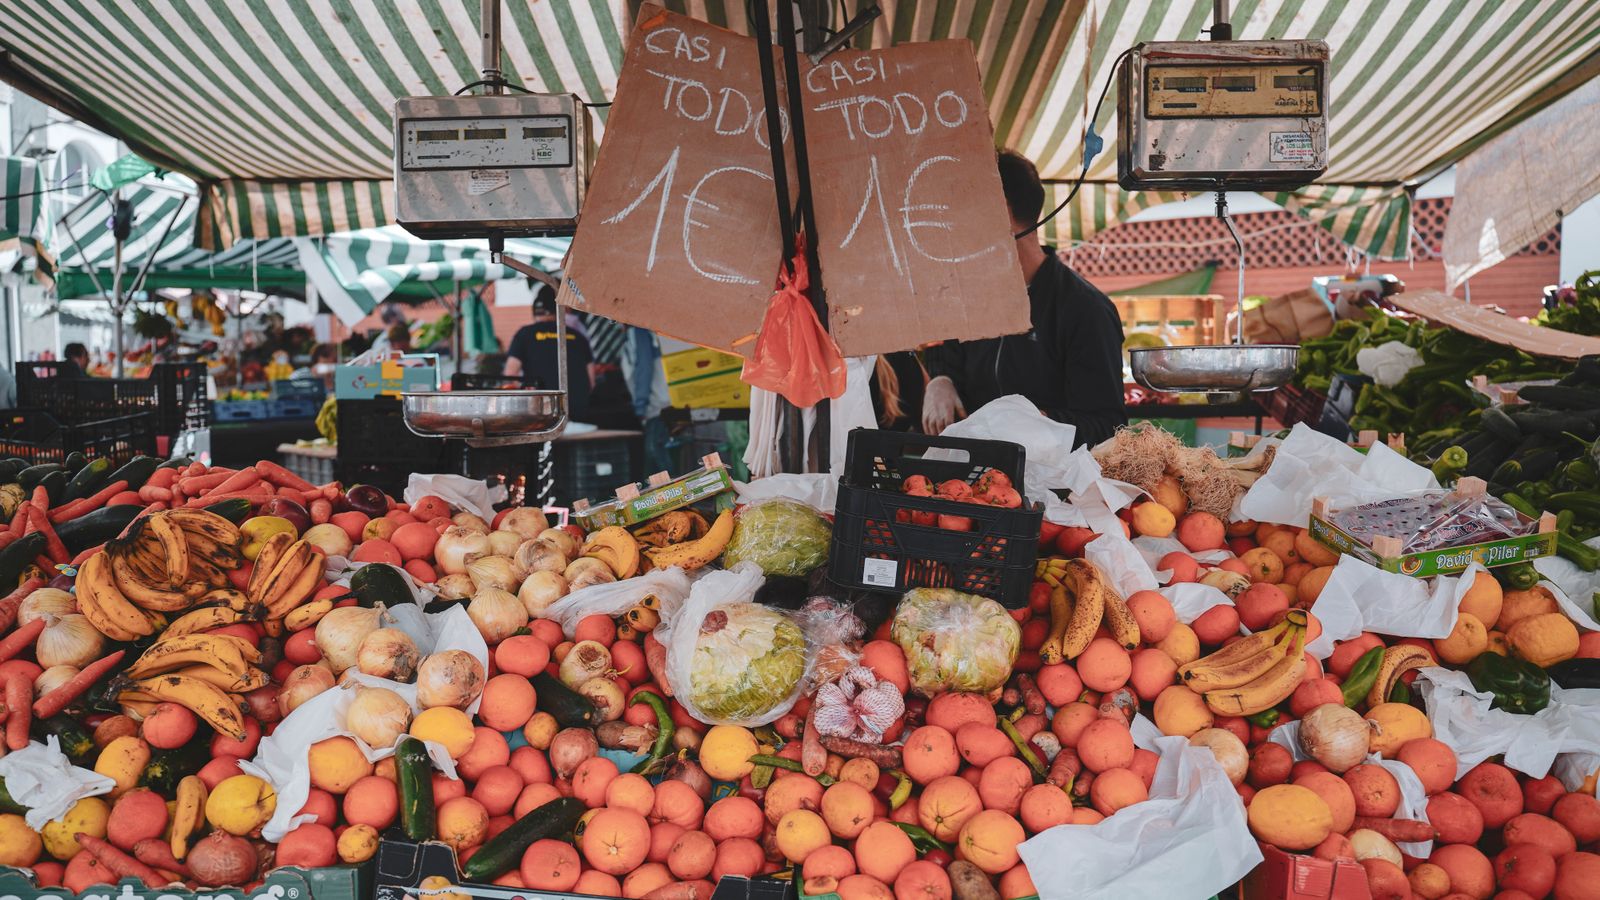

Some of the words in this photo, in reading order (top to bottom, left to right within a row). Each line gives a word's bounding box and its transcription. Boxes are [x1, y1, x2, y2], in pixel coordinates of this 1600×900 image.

[645, 27, 726, 70] CASI
[806, 55, 886, 93] CASI
[645, 69, 789, 150] TODO
[813, 90, 968, 141] TODO
[1436, 550, 1474, 569] David
[1487, 545, 1521, 565] Pilar
